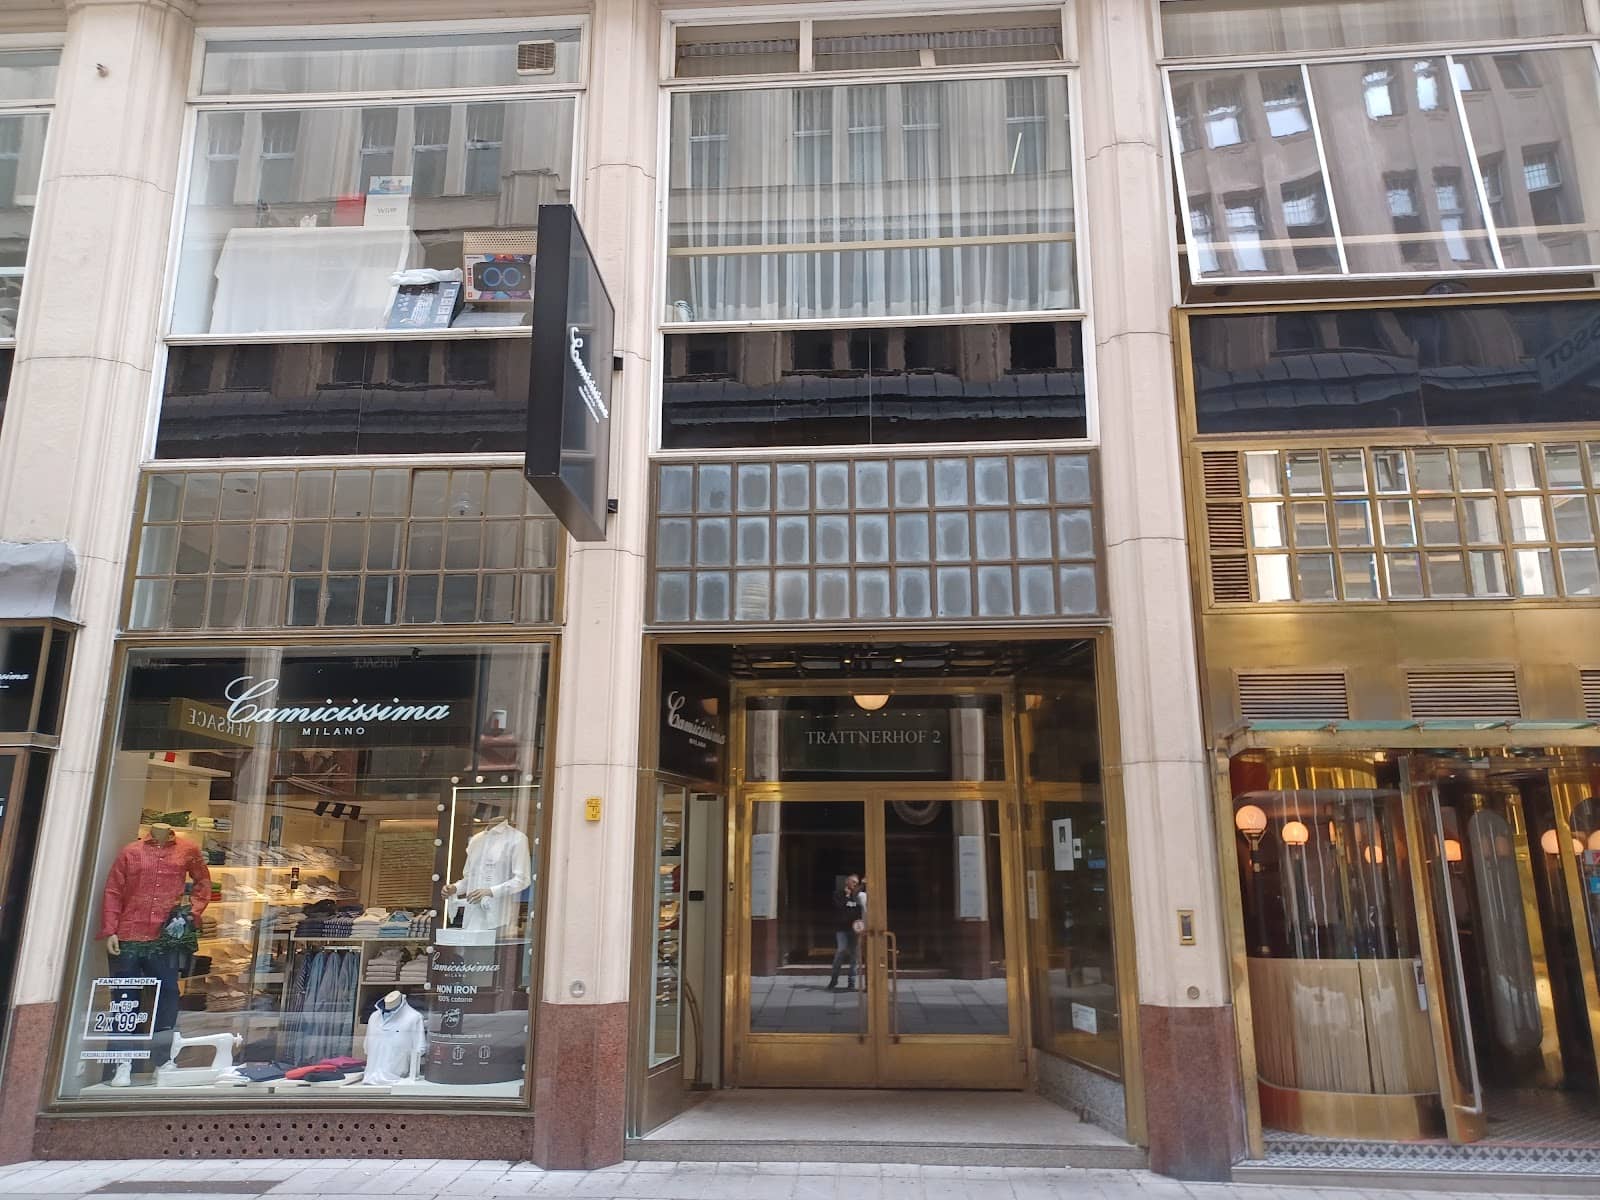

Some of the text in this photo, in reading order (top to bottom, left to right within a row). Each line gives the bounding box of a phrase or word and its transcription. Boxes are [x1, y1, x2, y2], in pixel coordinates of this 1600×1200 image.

[225, 676, 450, 723] Camicissima
[302, 727, 366, 736] MILANO
[805, 730, 942, 744] TRATTNERHOF 2
[436, 984, 478, 994] NON IRON
